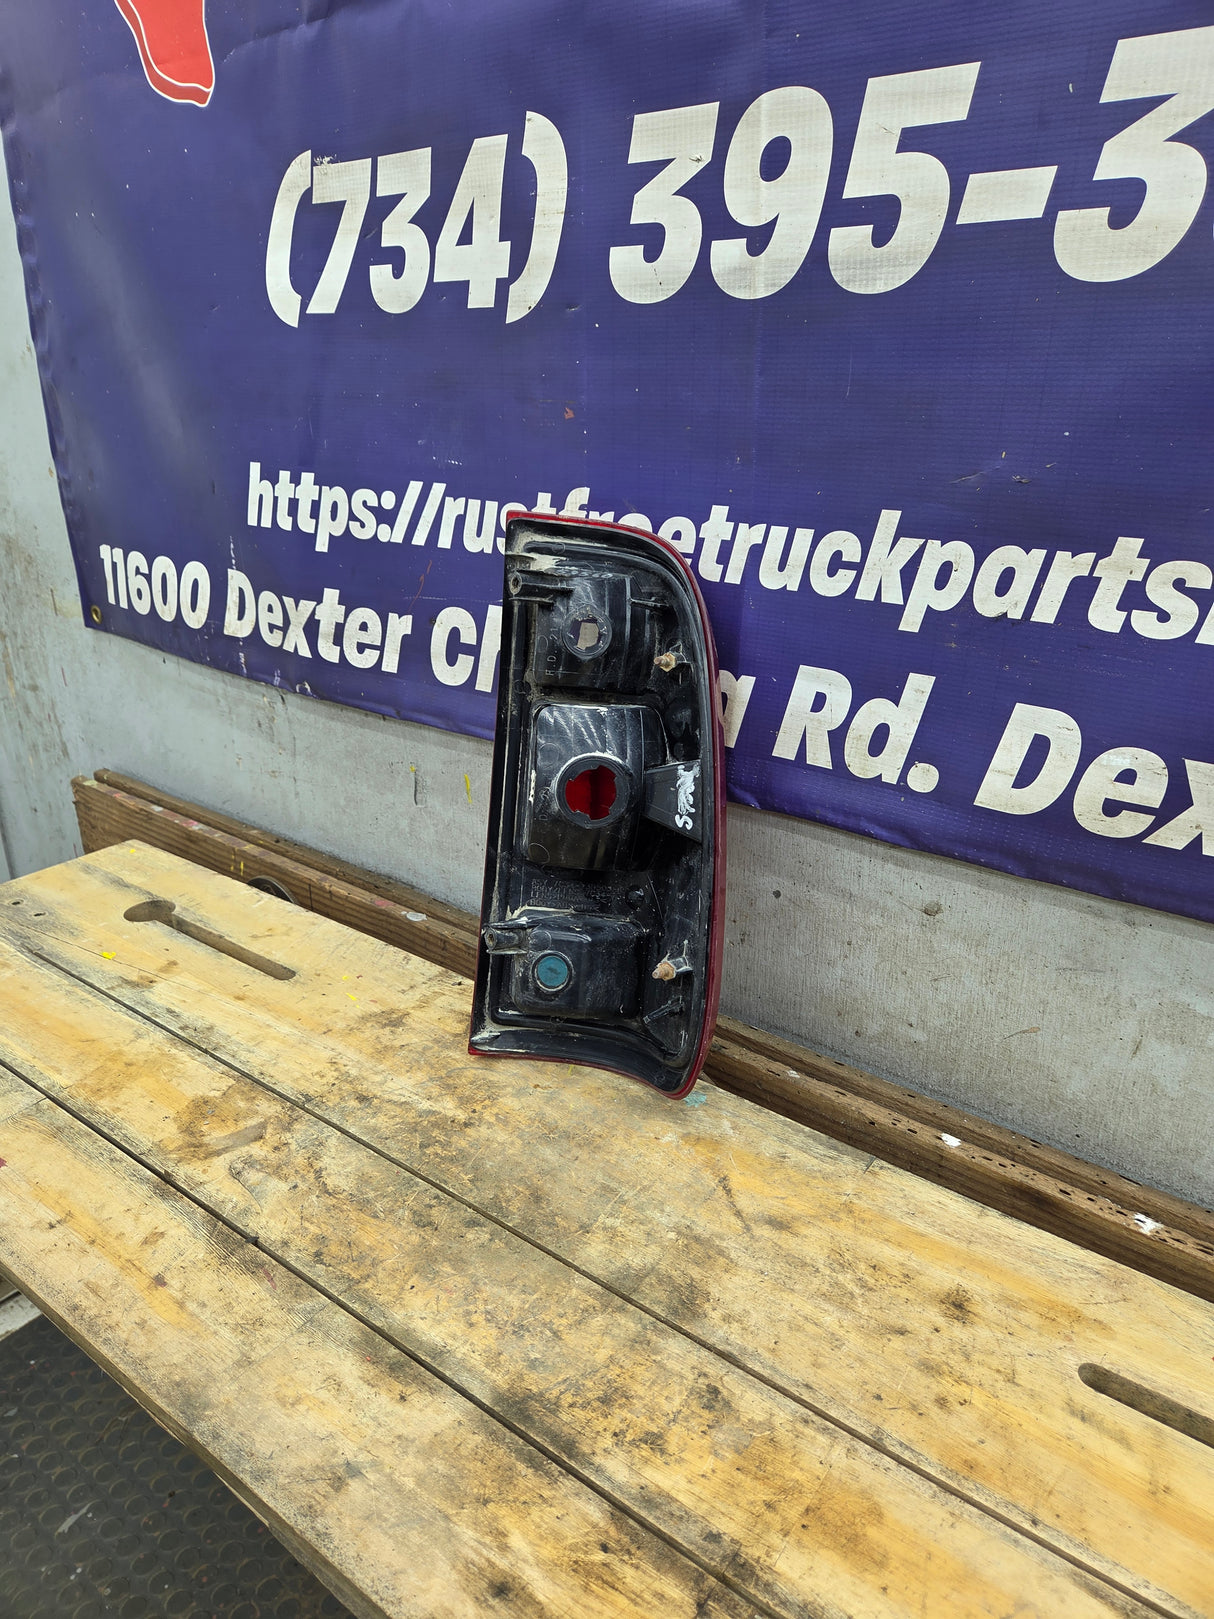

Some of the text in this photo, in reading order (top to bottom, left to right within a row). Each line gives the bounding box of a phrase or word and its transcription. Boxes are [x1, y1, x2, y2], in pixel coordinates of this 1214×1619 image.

[265, 24, 1214, 328] (734) 395-3
[99, 543, 211, 630] 11600
[223, 565, 413, 674] Dexter
[771, 664, 940, 794] Rd.
